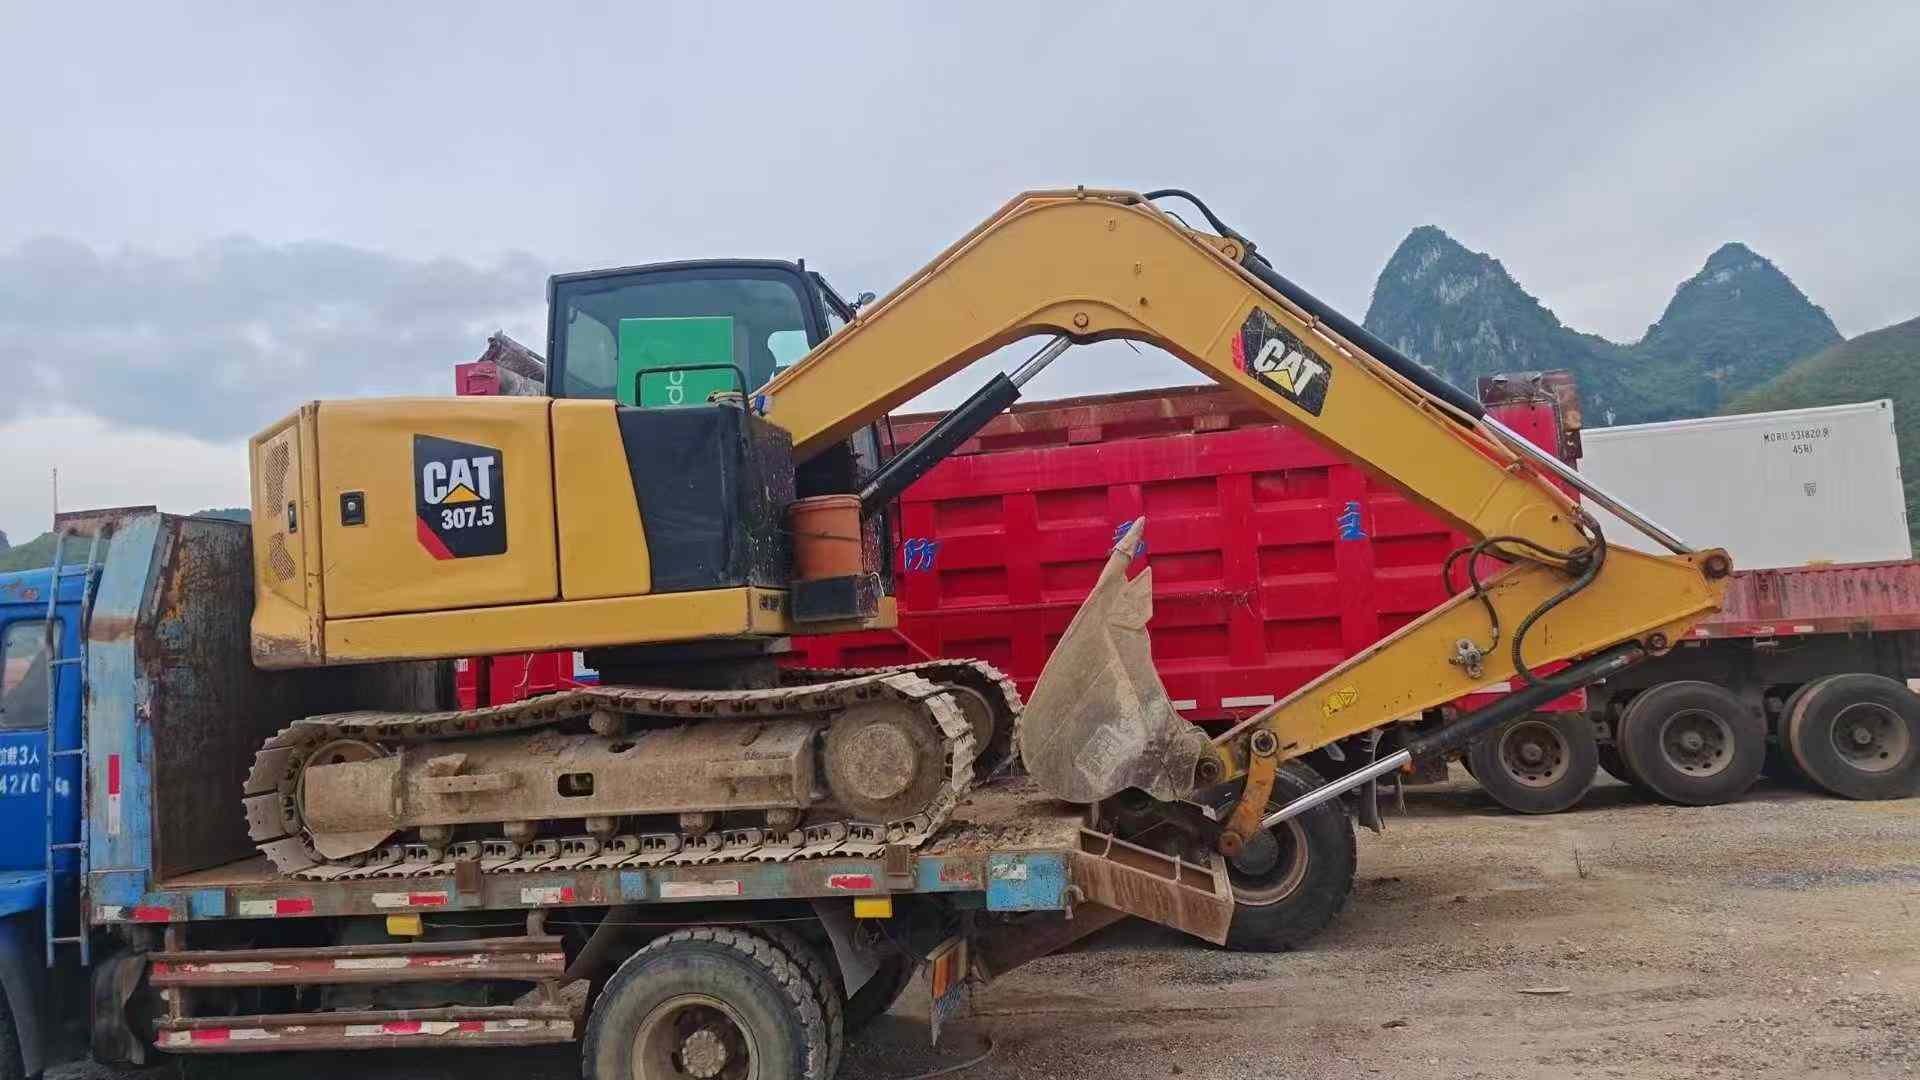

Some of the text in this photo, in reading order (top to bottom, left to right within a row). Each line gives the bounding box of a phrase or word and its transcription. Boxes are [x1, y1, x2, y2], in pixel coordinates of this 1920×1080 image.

[1253, 337, 1324, 397] CAT
[423, 456, 494, 505] CAT
[441, 505, 494, 530] 307.5
